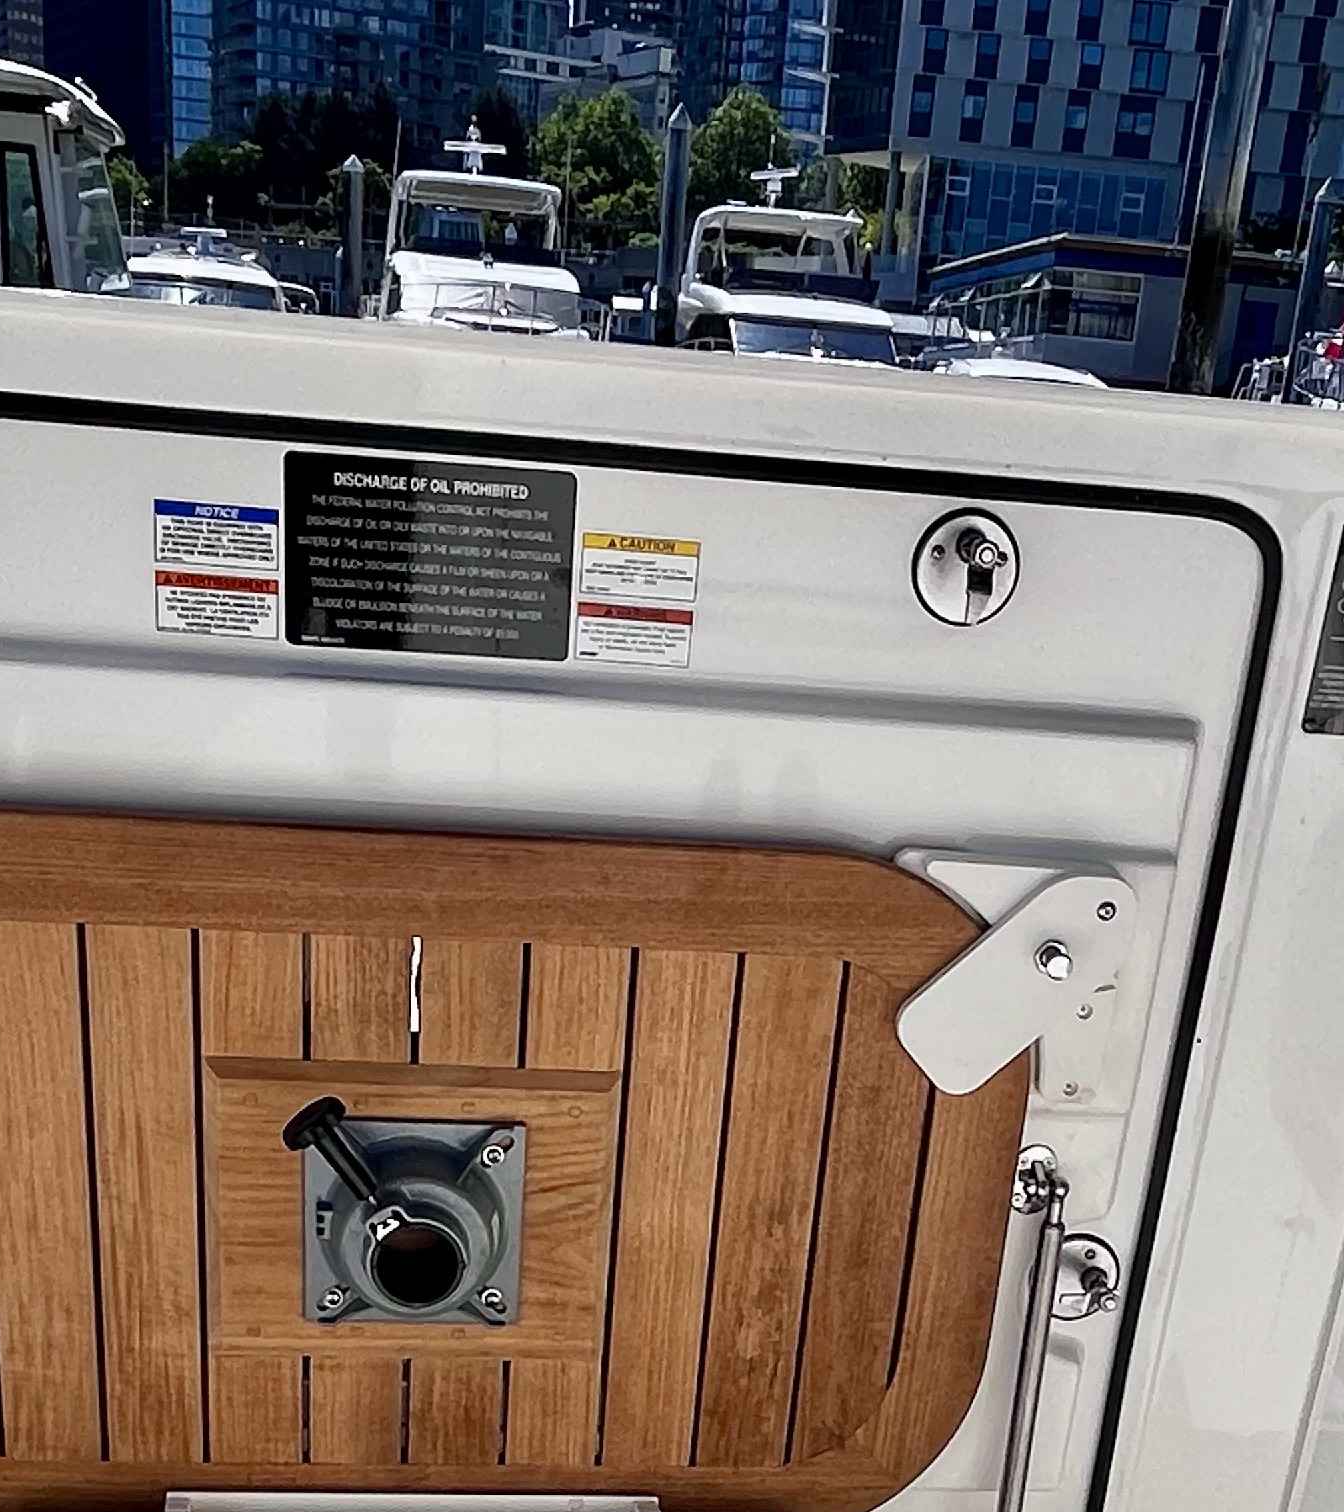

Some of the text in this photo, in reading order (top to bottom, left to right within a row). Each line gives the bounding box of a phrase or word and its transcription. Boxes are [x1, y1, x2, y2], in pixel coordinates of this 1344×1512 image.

[333, 472, 529, 500] DISCHARGE OF OIL PROHIBITED
[194, 506, 239, 519] NOTICE
[620, 537, 676, 552] CAUTION
